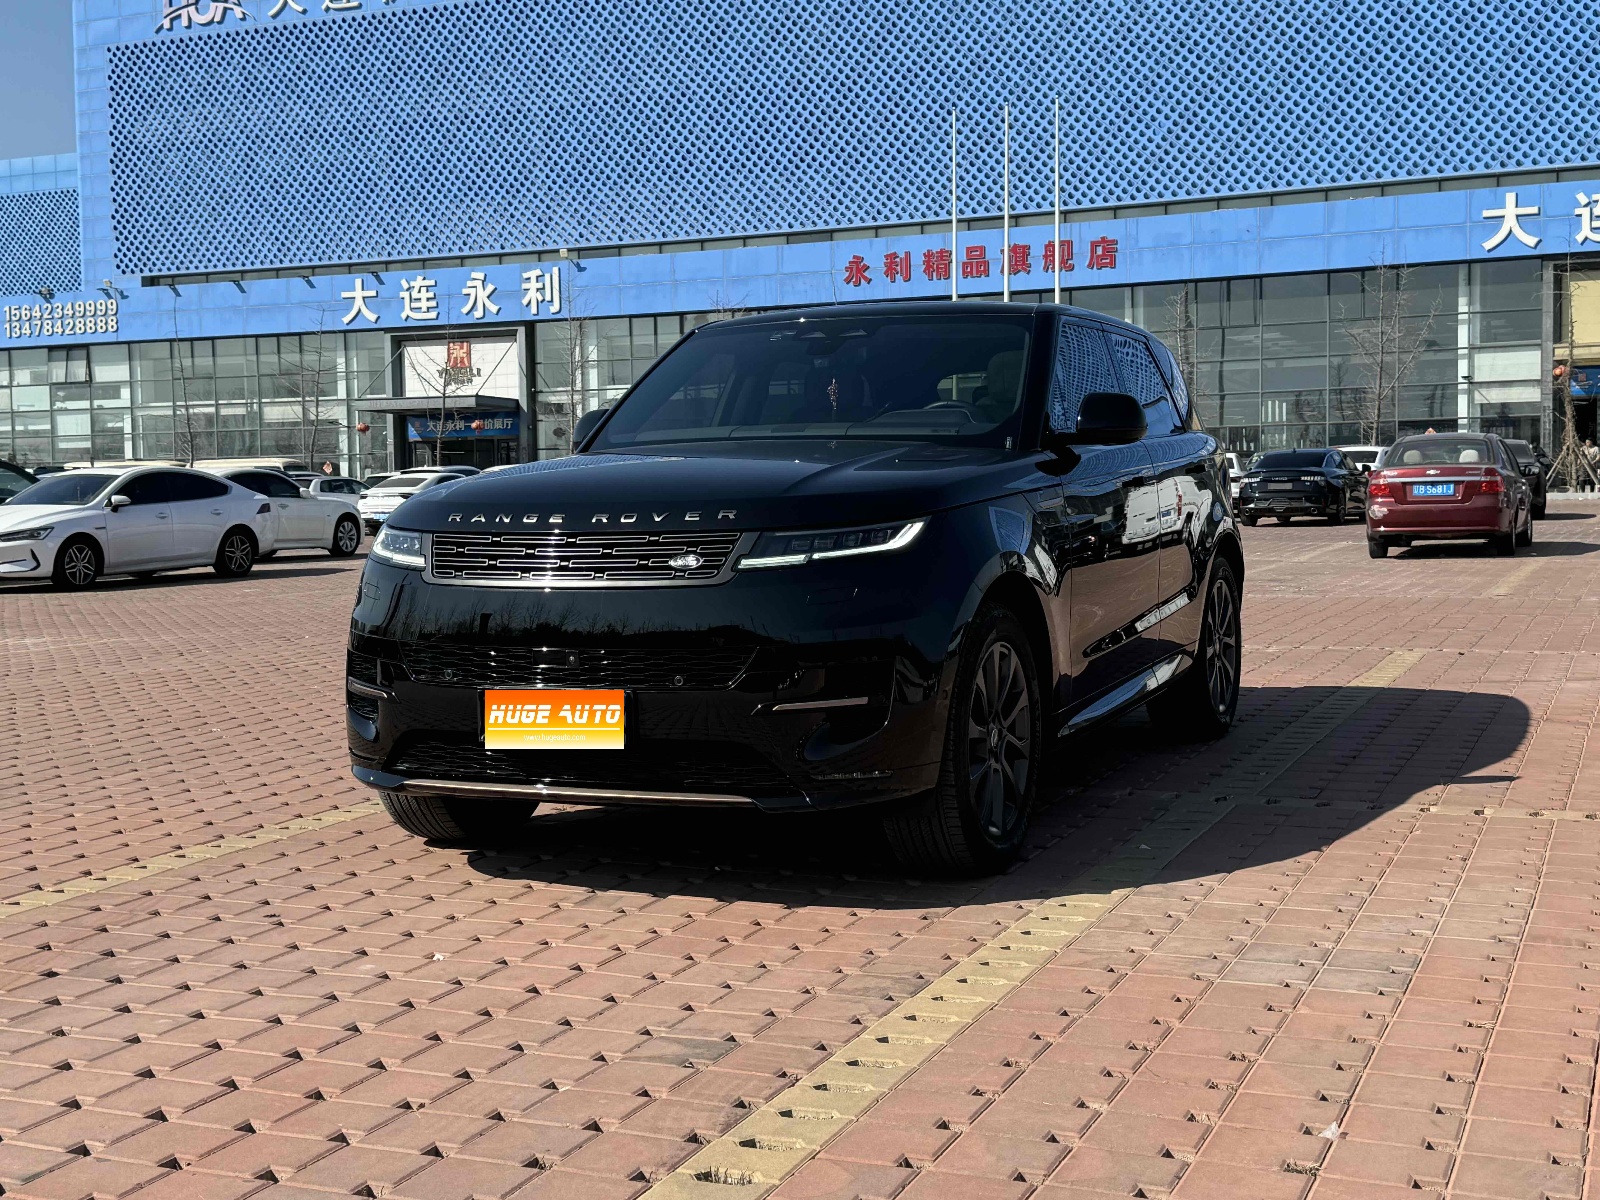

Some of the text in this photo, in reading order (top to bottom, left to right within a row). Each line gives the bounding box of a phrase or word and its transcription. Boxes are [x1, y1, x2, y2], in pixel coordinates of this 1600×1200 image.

[843, 236, 1118, 286] 永利精品旗舰店
[341, 266, 562, 324] 大连永利
[4, 300, 117, 321] 15642349999
[4, 317, 117, 338] 13478428888
[427, 419, 513, 431] 大连永利一价展厅
[448, 509, 738, 523] RANGE ROVER
